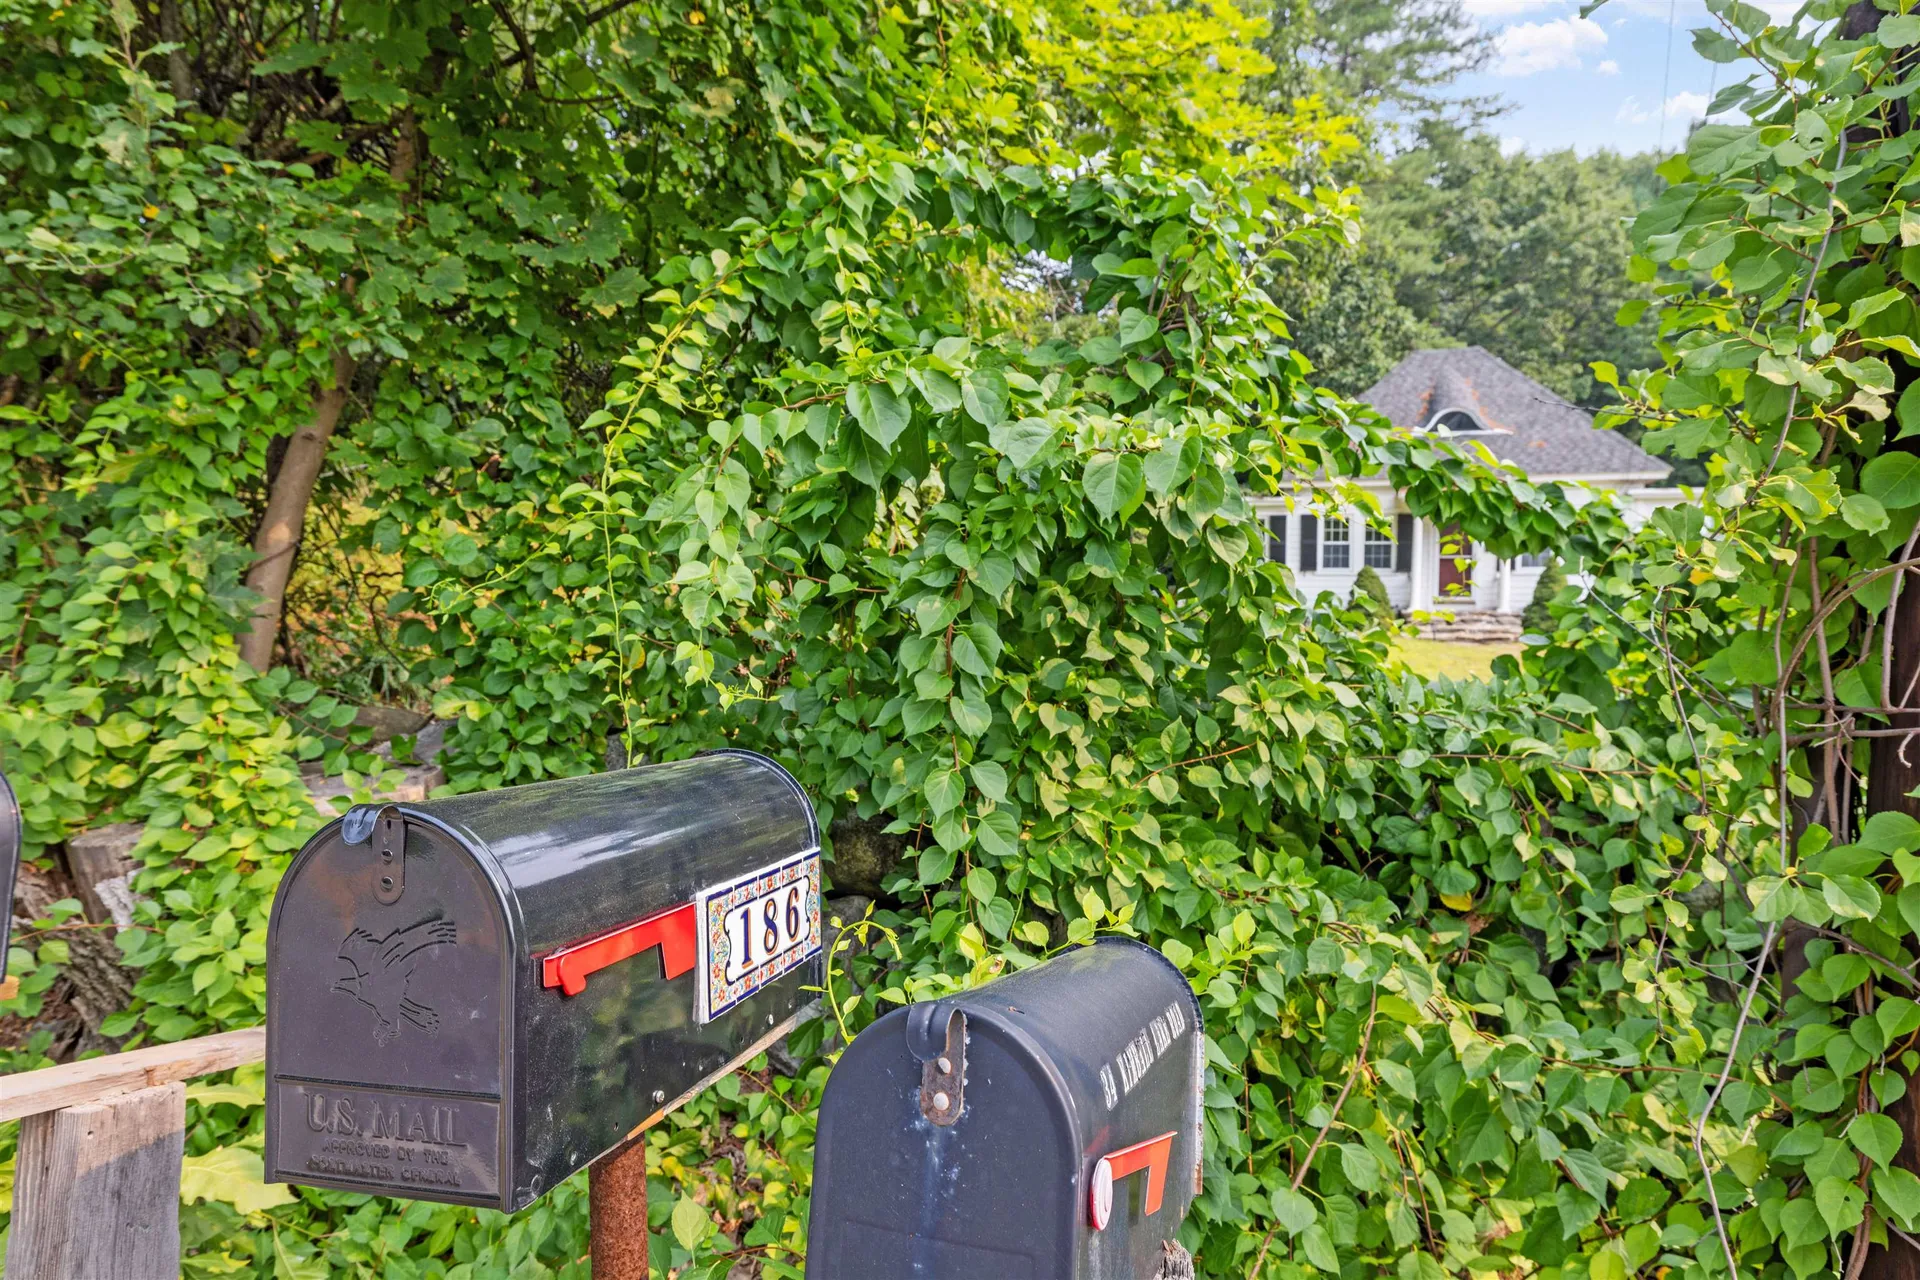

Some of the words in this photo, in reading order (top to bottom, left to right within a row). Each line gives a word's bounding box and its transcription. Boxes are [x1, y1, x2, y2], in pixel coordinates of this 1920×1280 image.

[740, 886, 800, 969] 186
[1100, 1063, 1118, 1111] 34
[304, 1093, 363, 1137] U.S.
[371, 1100, 468, 1147] MAIL
[322, 1138, 390, 1159] APPROVED
[397, 1145, 415, 1163] BY
[424, 1148, 449, 1166] THE
